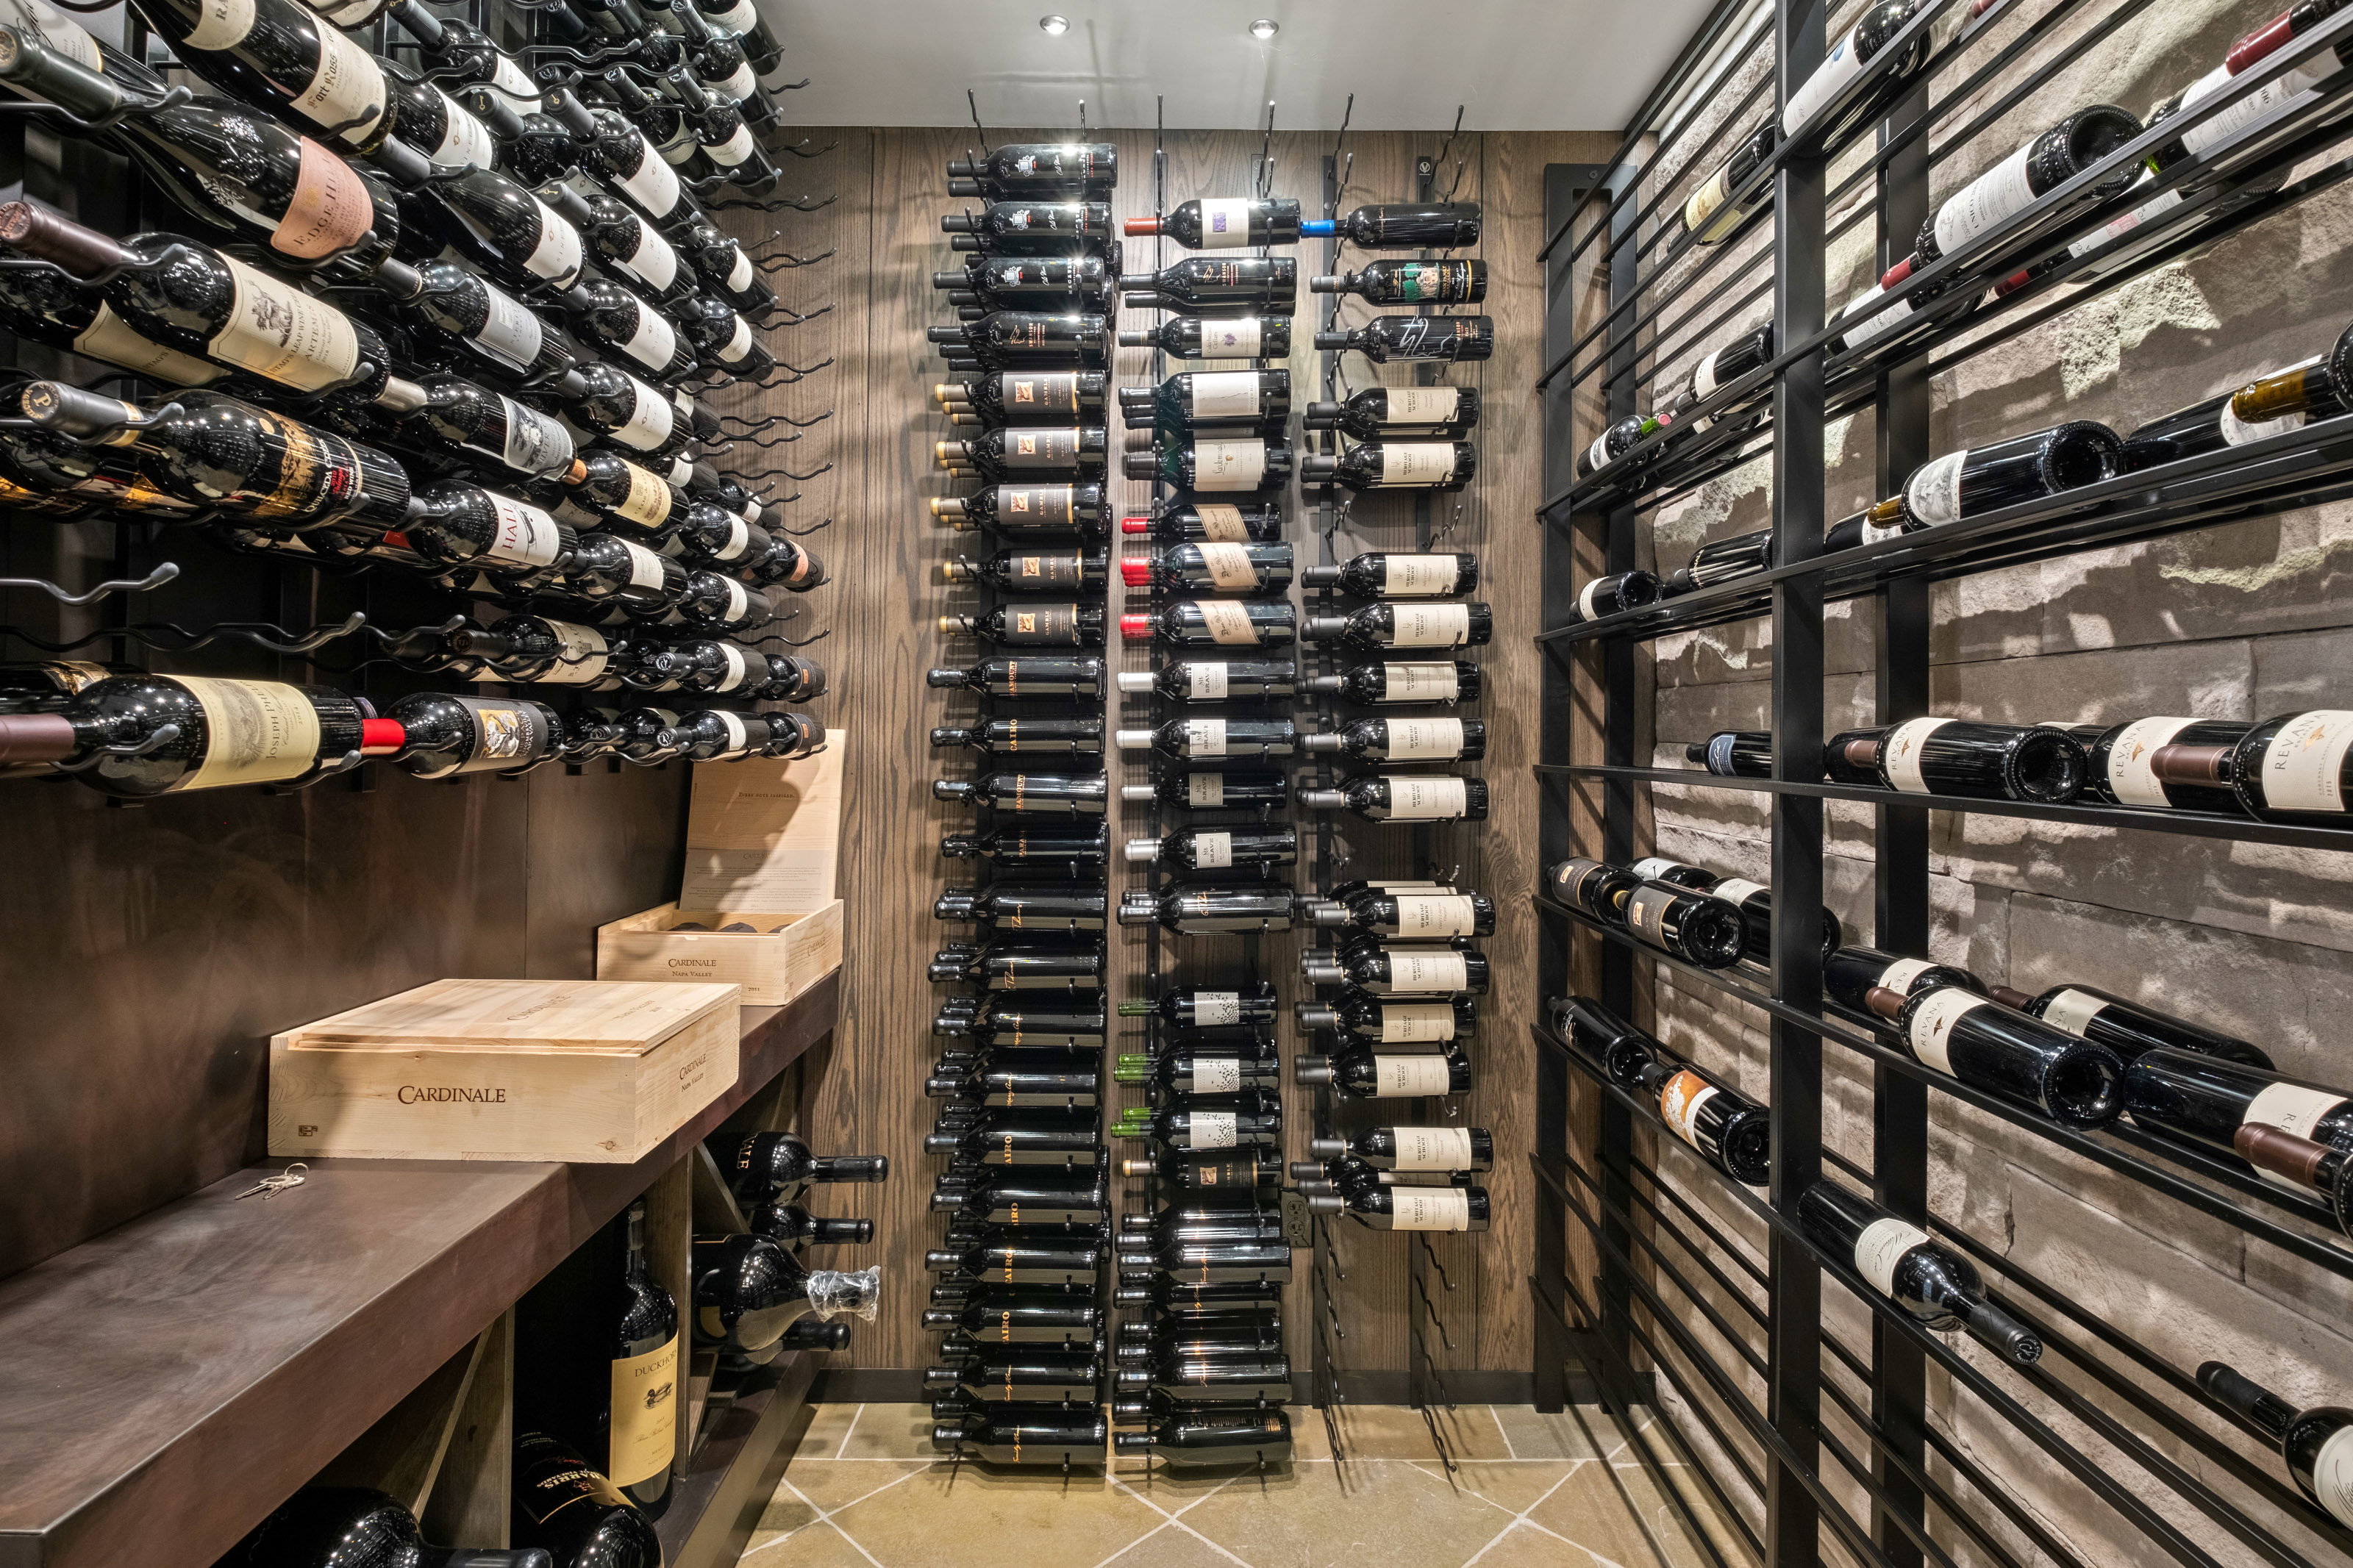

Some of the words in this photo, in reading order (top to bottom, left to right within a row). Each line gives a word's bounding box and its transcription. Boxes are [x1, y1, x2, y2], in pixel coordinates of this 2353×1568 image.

[307, 85, 329, 109] Fort
[293, 205, 334, 246] EDGE
[293, 329, 302, 354] LEAP
[34, 393, 52, 407] P
[304, 471, 332, 512] QUILCEDA
[344, 486, 353, 500] RED
[502, 506, 518, 550] HALL
[265, 715, 281, 759] JOSEPH
[1892, 726, 1913, 770] REVANA
[2116, 725, 2146, 778] REVANA
[2274, 709, 2329, 770] REVANA
[668, 959, 716, 967] CARDINALE
[1921, 1001, 1944, 1047] REVANA
[679, 1053, 707, 1080] CARDINALE
[398, 1085, 506, 1105] CARDINALE
[681, 1081, 691, 1093] NAPA
[691, 1073, 704, 1087] VALLEY
[1004, 1135, 1013, 1165] AIRO
[1001, 1311, 1010, 1344] AIRO
[543, 1470, 601, 1489] HARRIS
